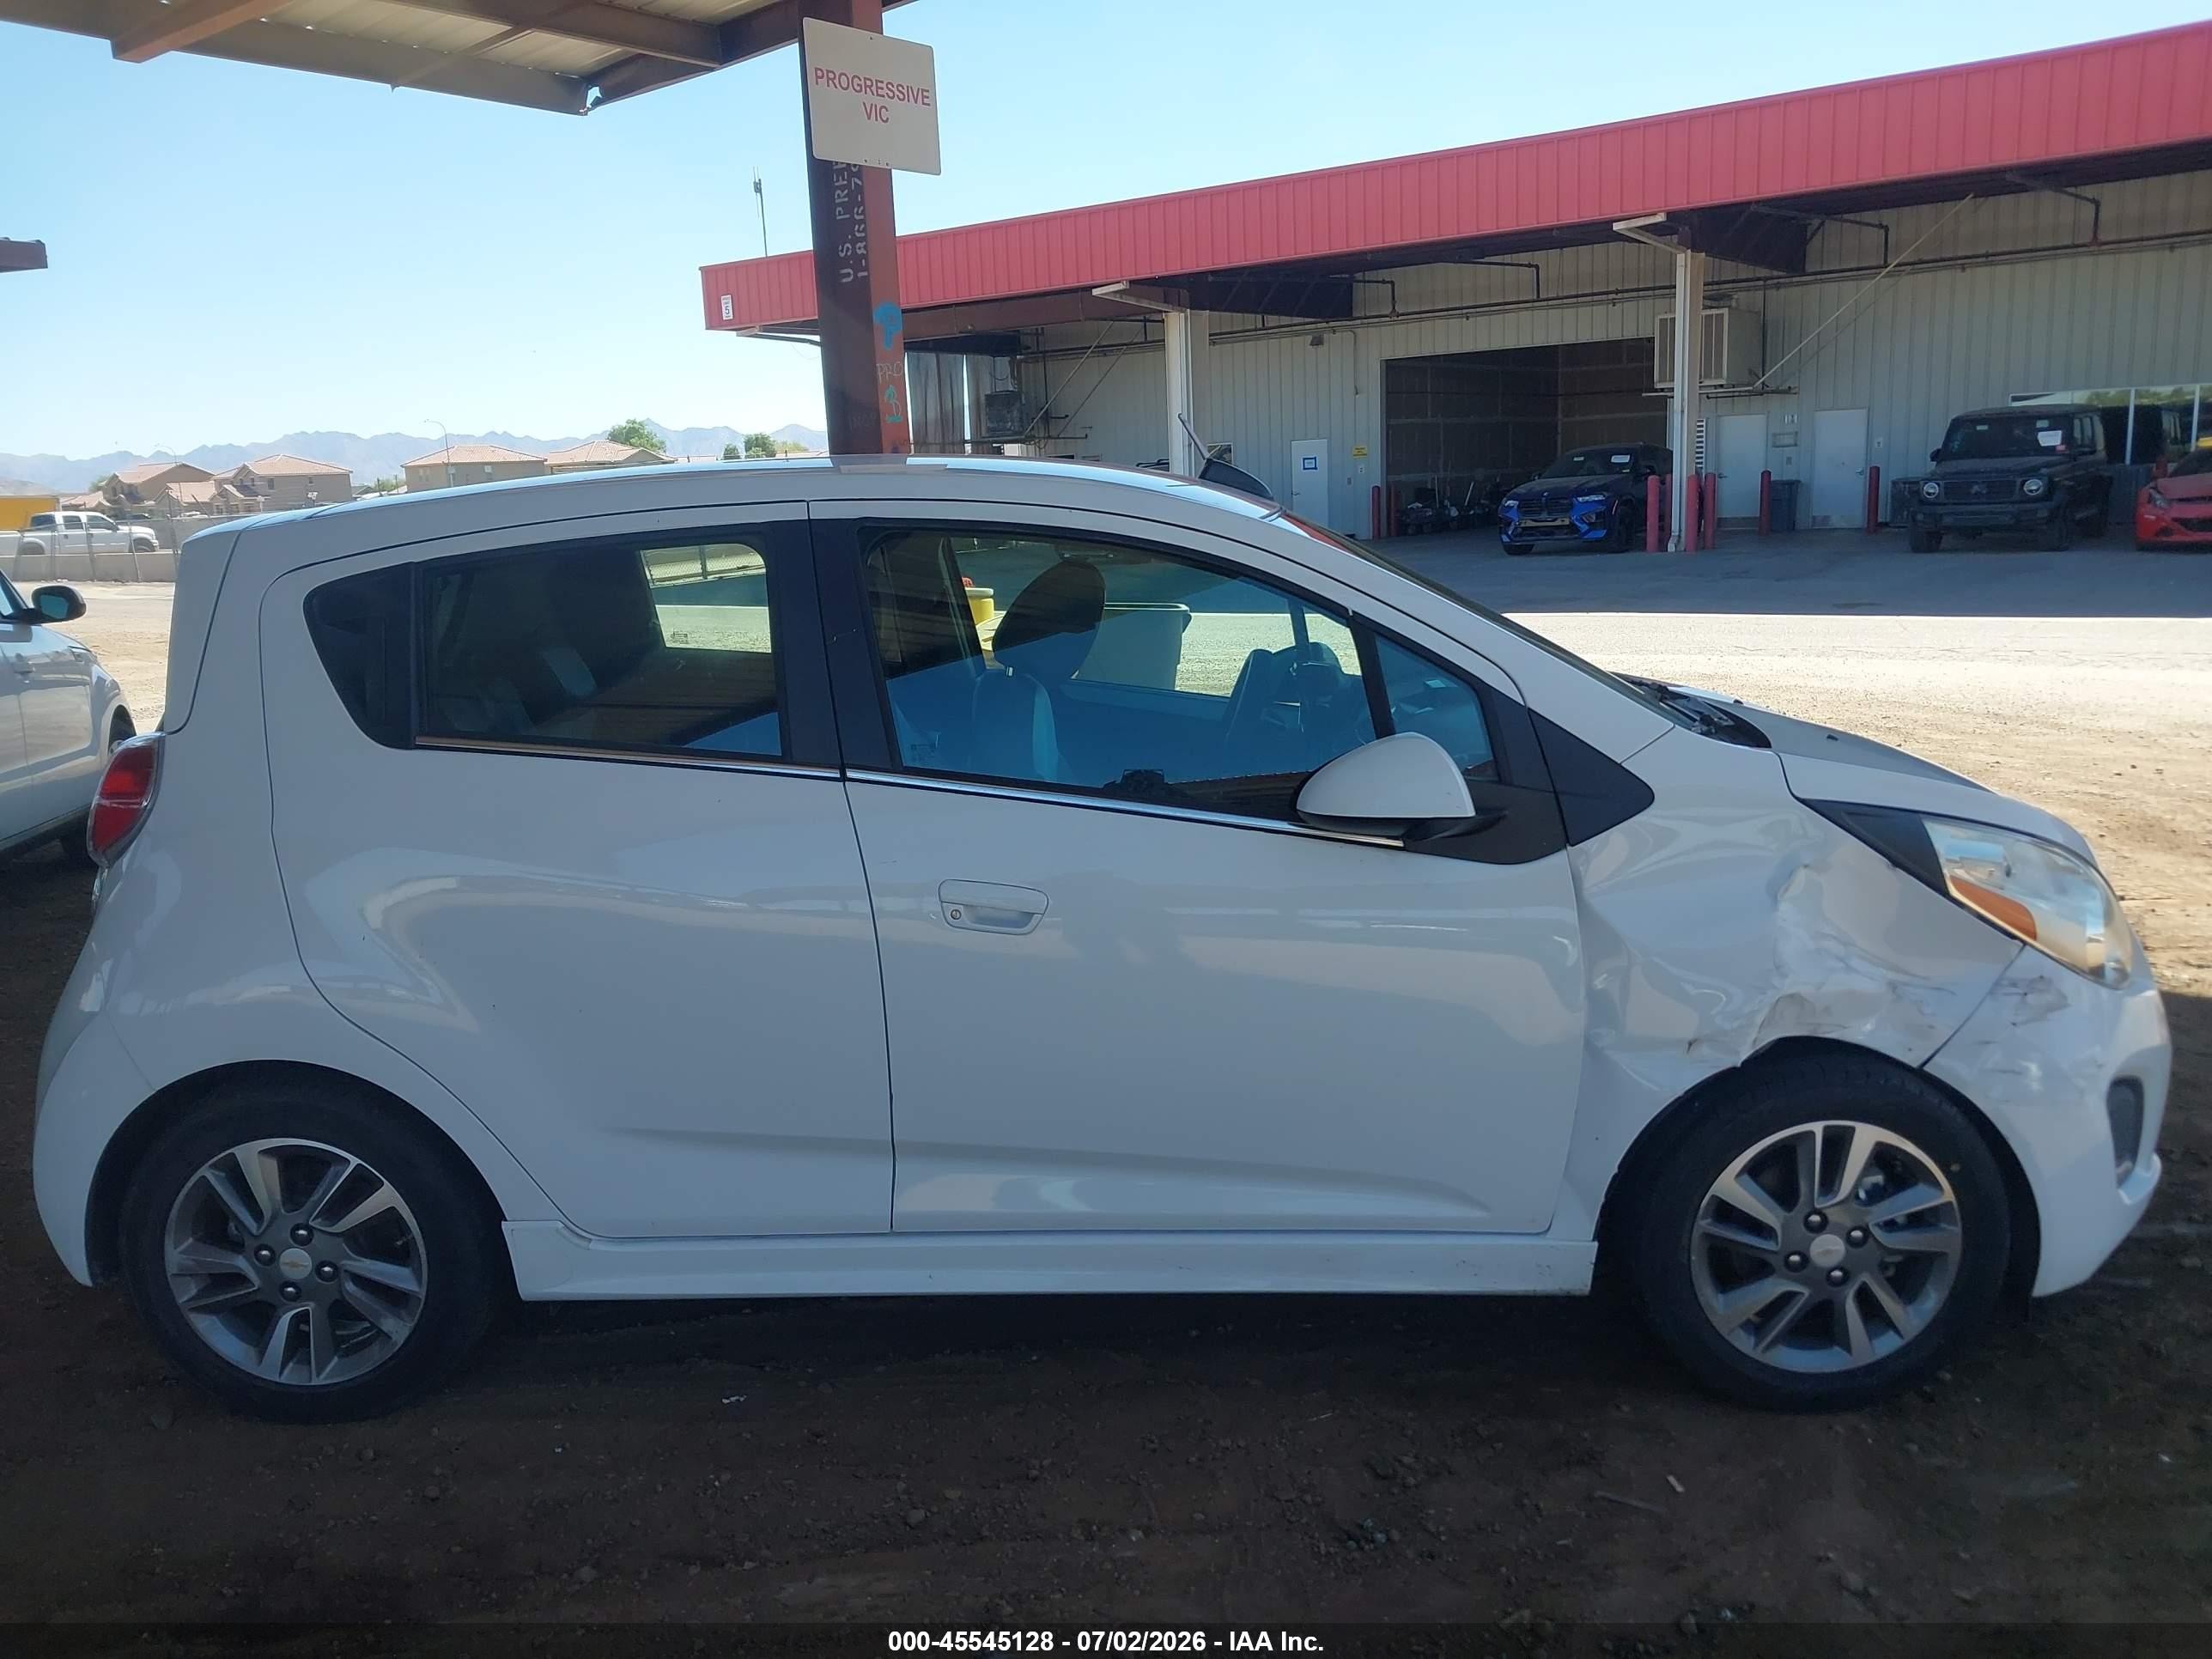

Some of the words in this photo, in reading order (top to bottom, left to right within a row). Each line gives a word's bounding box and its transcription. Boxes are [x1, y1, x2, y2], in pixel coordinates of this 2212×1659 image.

[814, 67, 931, 106] PROGRESSIVE
[862, 101, 890, 124] VIC
[833, 161, 850, 220] PRE
